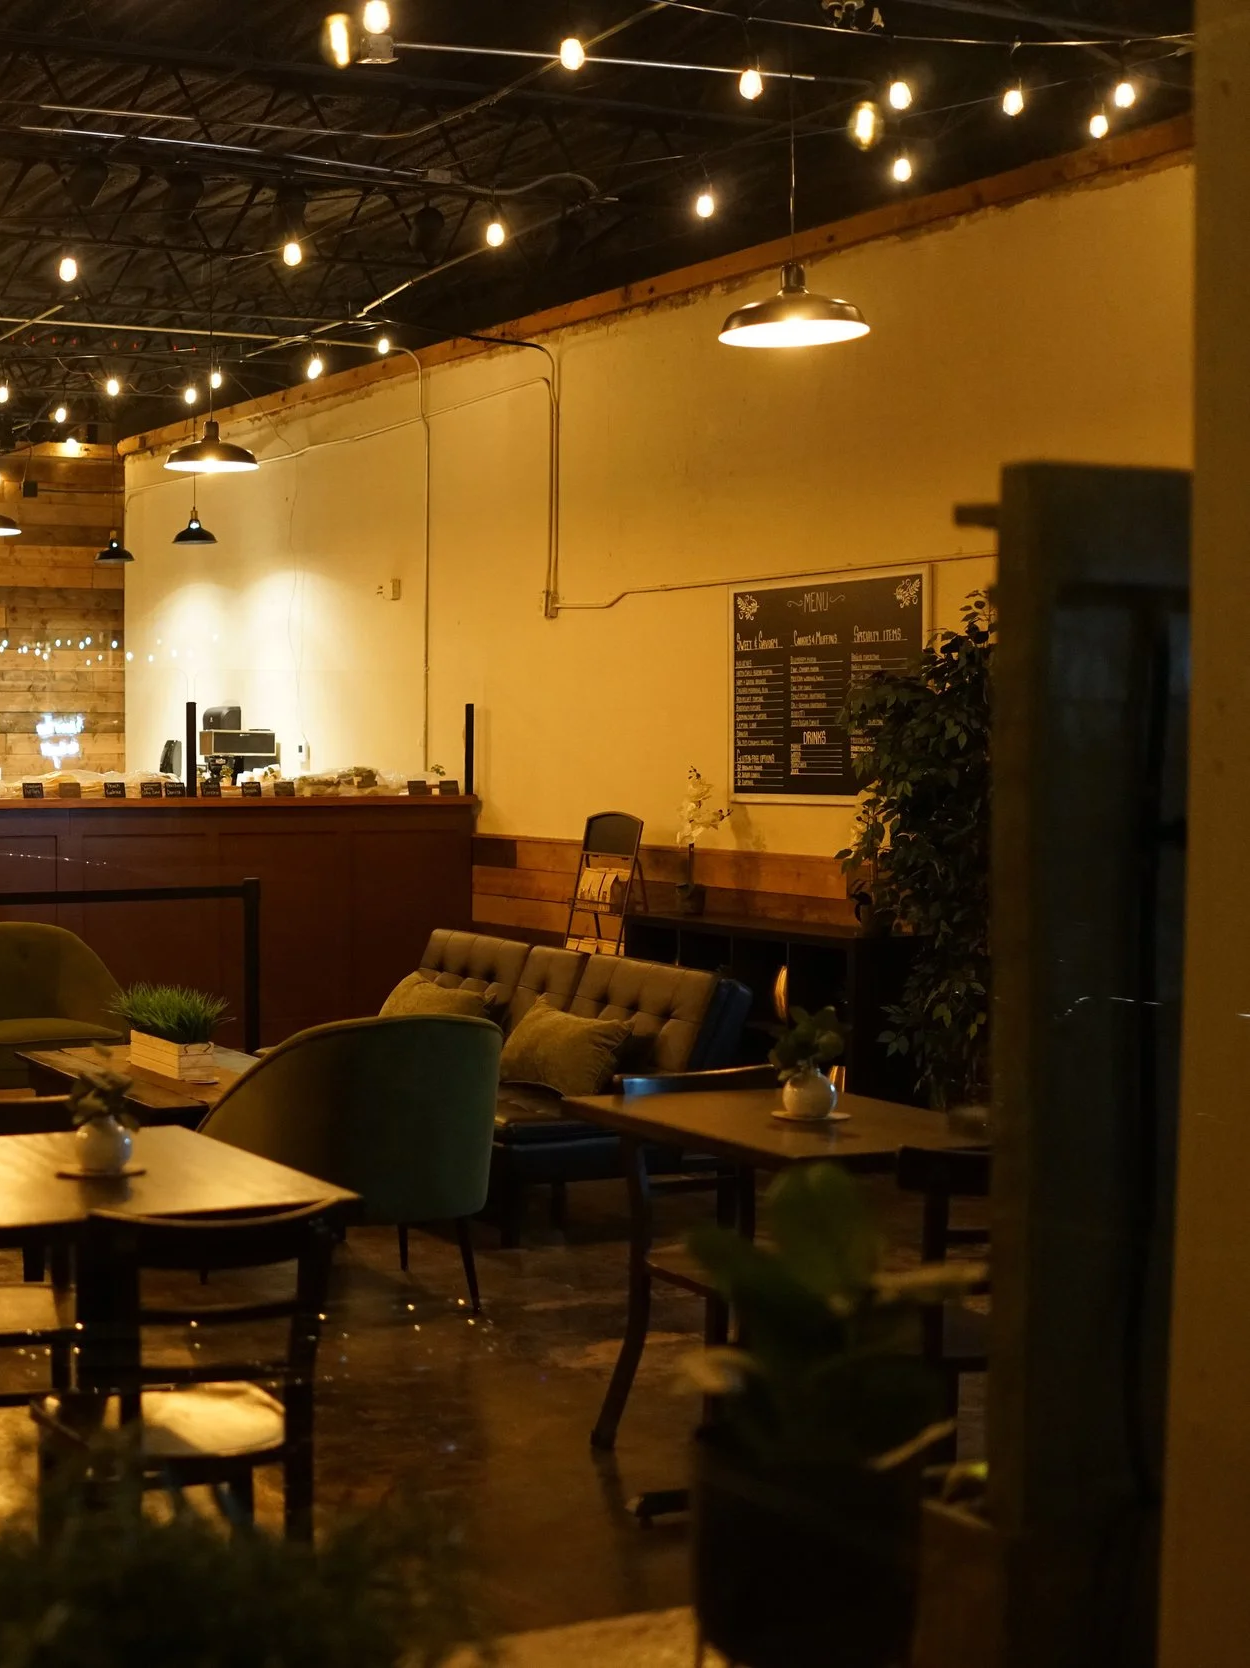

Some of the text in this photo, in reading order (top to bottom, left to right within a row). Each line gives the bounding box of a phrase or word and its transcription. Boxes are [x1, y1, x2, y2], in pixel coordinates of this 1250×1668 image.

[803, 592, 829, 613] MENU
[883, 627, 902, 641] ITEMS
[803, 730, 827, 745] DRINKS
